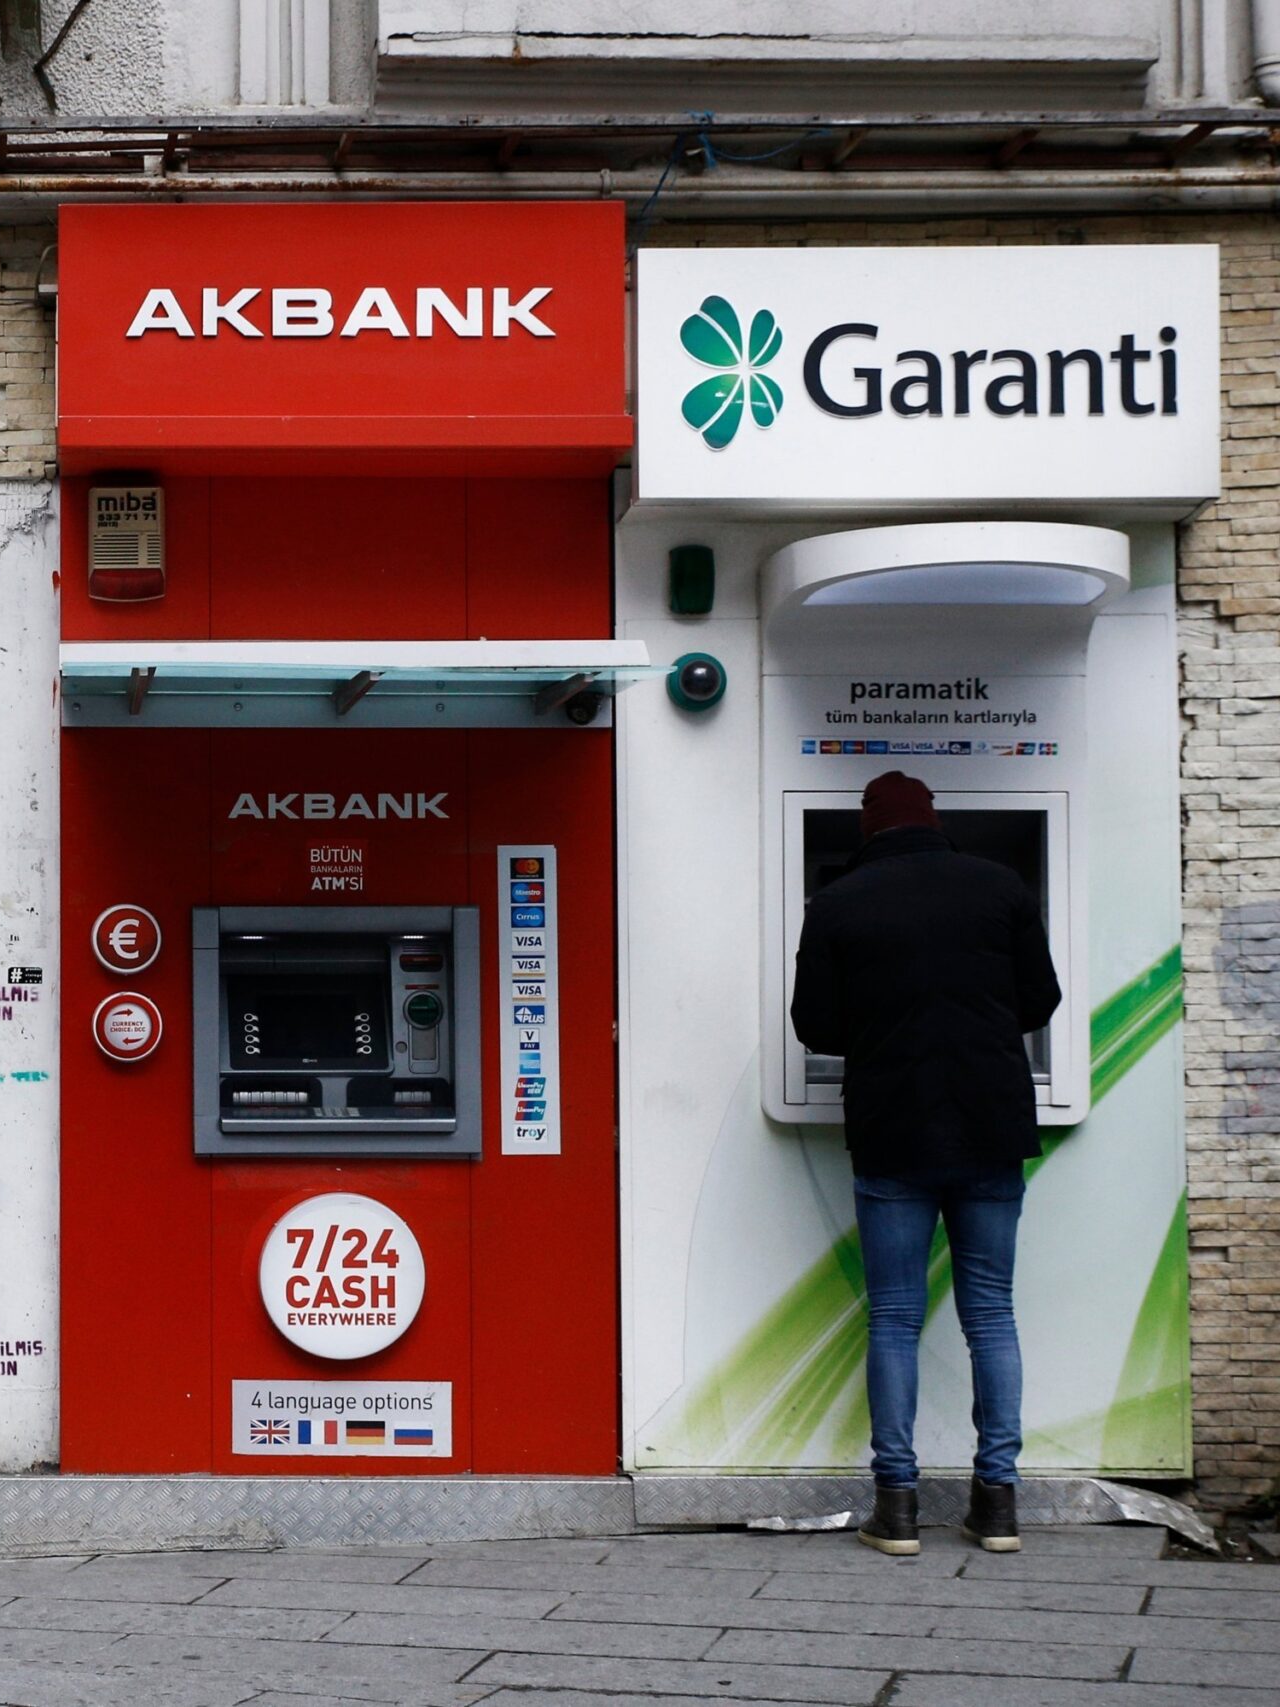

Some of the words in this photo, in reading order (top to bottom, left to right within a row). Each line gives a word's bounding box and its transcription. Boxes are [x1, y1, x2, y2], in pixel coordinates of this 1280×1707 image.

[126, 288, 556, 337] AKBANK
[803, 323, 1179, 419] Garanti
[850, 677, 990, 704] paramatik
[825, 710, 858, 724] tüm
[863, 710, 949, 724] bankaların
[954, 709, 1037, 727] kartlarıyla
[228, 792, 450, 819] AKBANK
[310, 845, 362, 862] BÜTÜN
[310, 865, 363, 873] BANKALARIN
[311, 873, 363, 890] ATM'Sİ
[514, 936, 542, 947] VISA
[517, 960, 541, 970] VISA
[517, 985, 542, 995] VISA
[524, 1014, 545, 1023] PLUS
[524, 1031, 534, 1041] V
[516, 1126, 546, 1140] troy
[286, 1224, 399, 1273] 7/24
[285, 1275, 396, 1309] CASH
[287, 1313, 396, 1326] EVERYWHERE
[251, 1391, 263, 1409] 4
[268, 1391, 357, 1415] language
[362, 1392, 433, 1415] options
